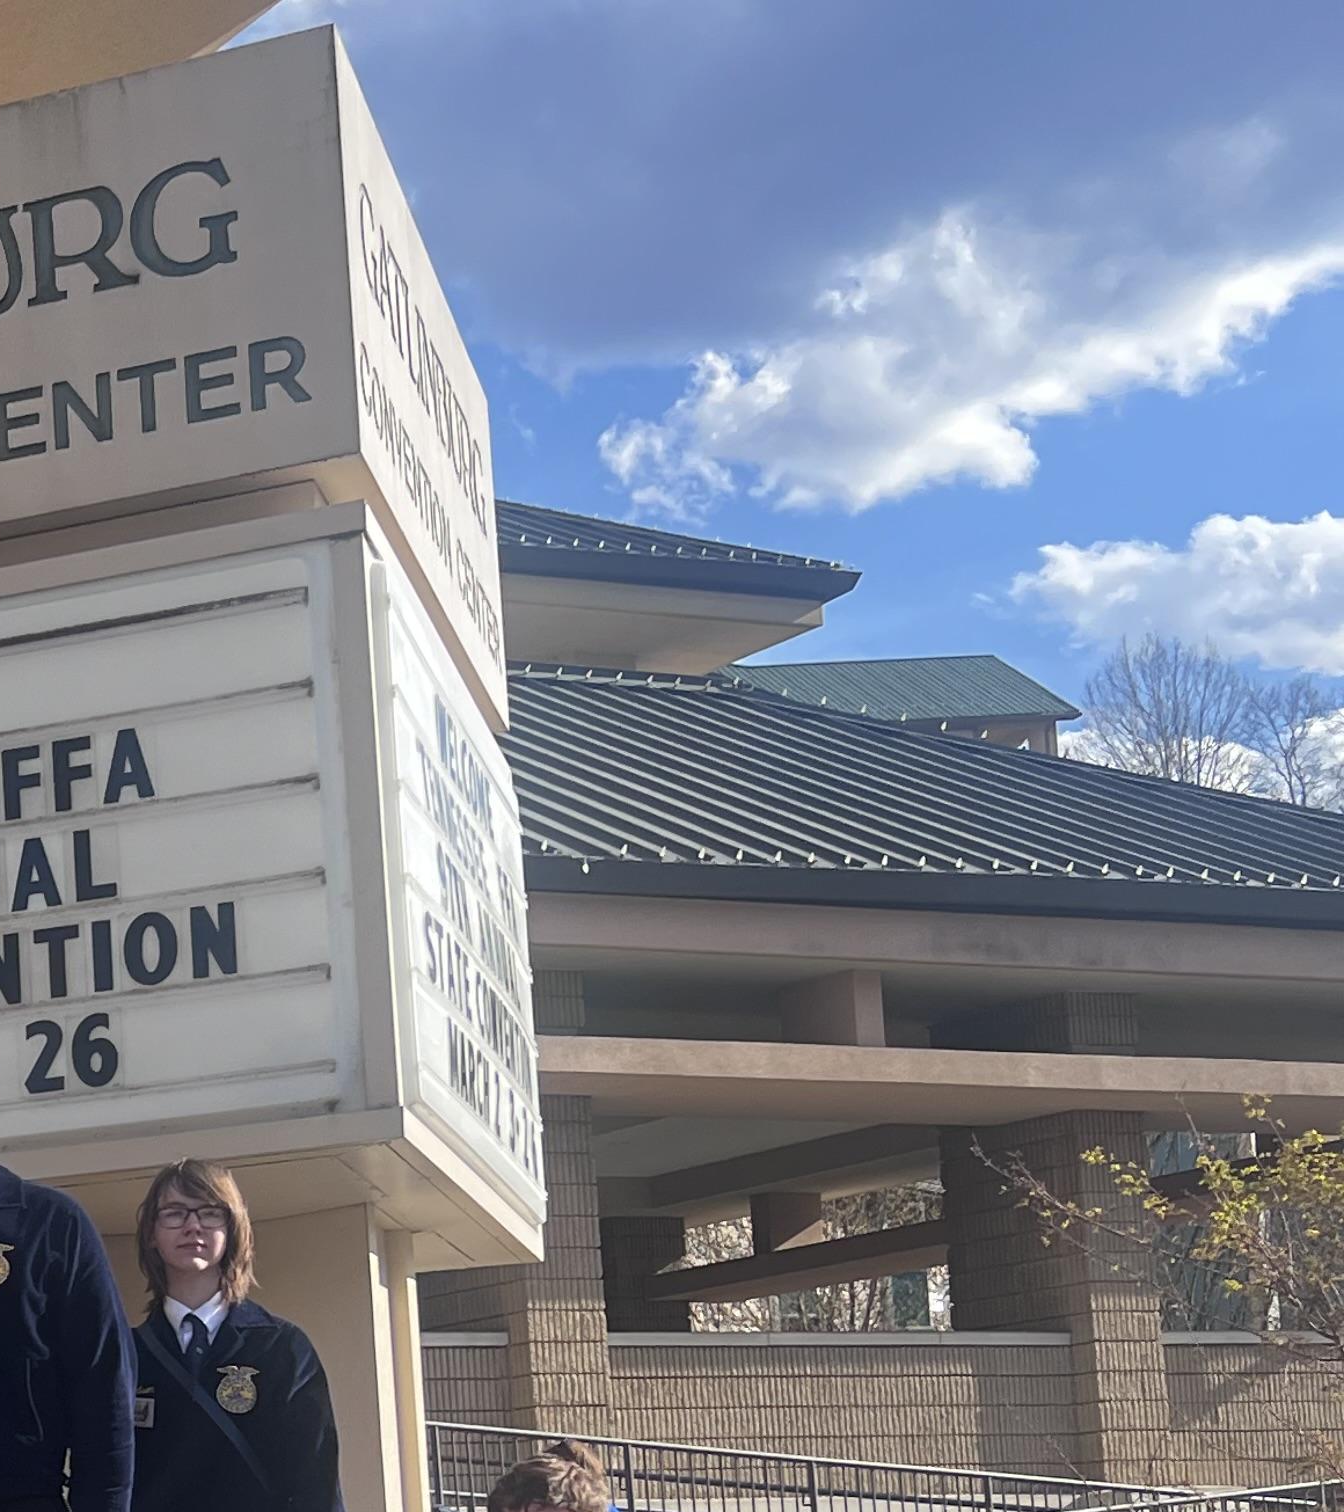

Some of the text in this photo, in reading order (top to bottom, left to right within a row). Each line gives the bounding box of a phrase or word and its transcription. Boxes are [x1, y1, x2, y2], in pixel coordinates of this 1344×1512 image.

[359, 183, 488, 538] GATLINBURG
[360, 342, 502, 675] CONVENTION CENTER
[2, 728, 156, 821] FFA
[435, 694, 494, 840] WELCOME
[424, 910, 472, 1023] STATE
[24, 1012, 119, 1094] 26
[447, 1016, 490, 1126] MARCH
